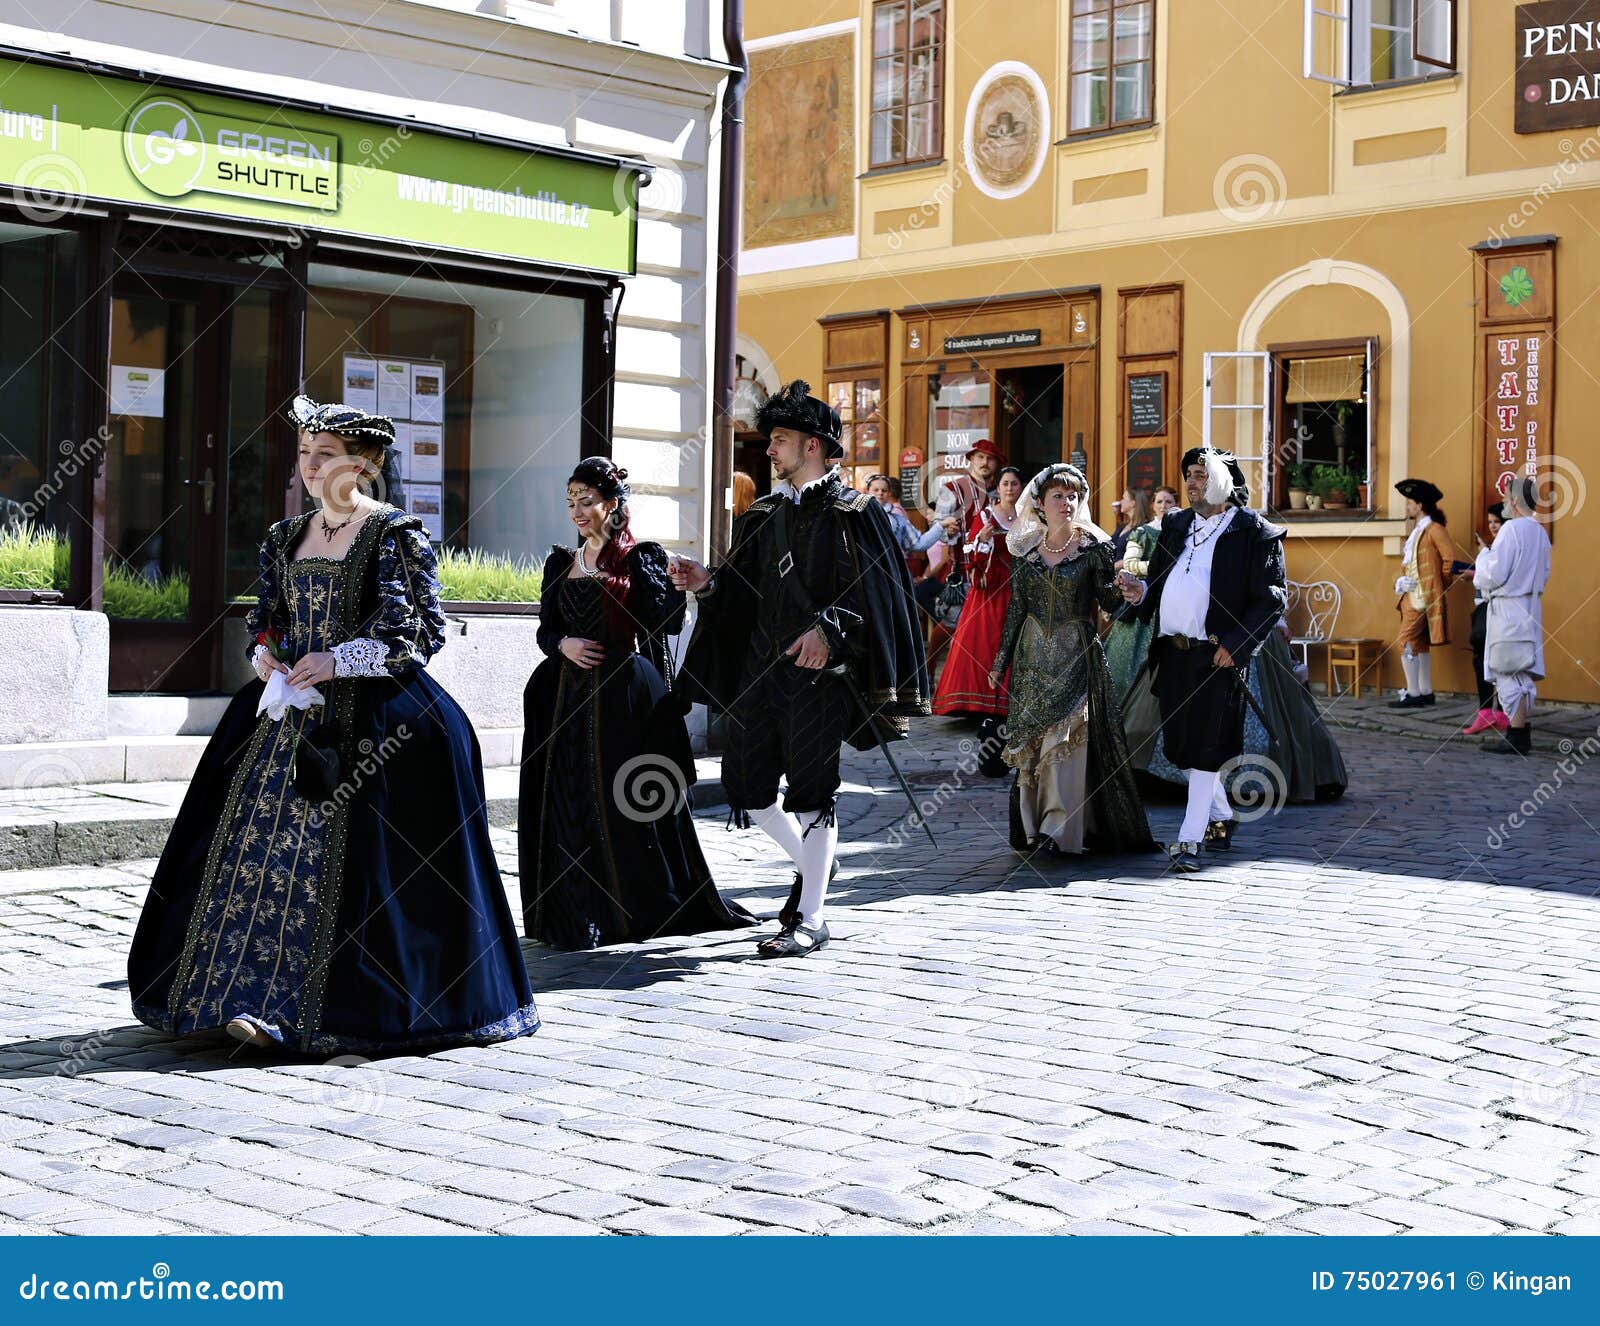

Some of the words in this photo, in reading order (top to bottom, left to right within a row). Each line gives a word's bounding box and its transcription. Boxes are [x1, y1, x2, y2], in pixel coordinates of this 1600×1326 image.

[217, 129, 329, 171] GREEN
[217, 161, 329, 195] SHUTTLE
[397, 174, 589, 228] www.greenshuttle.cz
[1527, 337, 1540, 405] HENNA
[947, 433, 970, 448] NON
